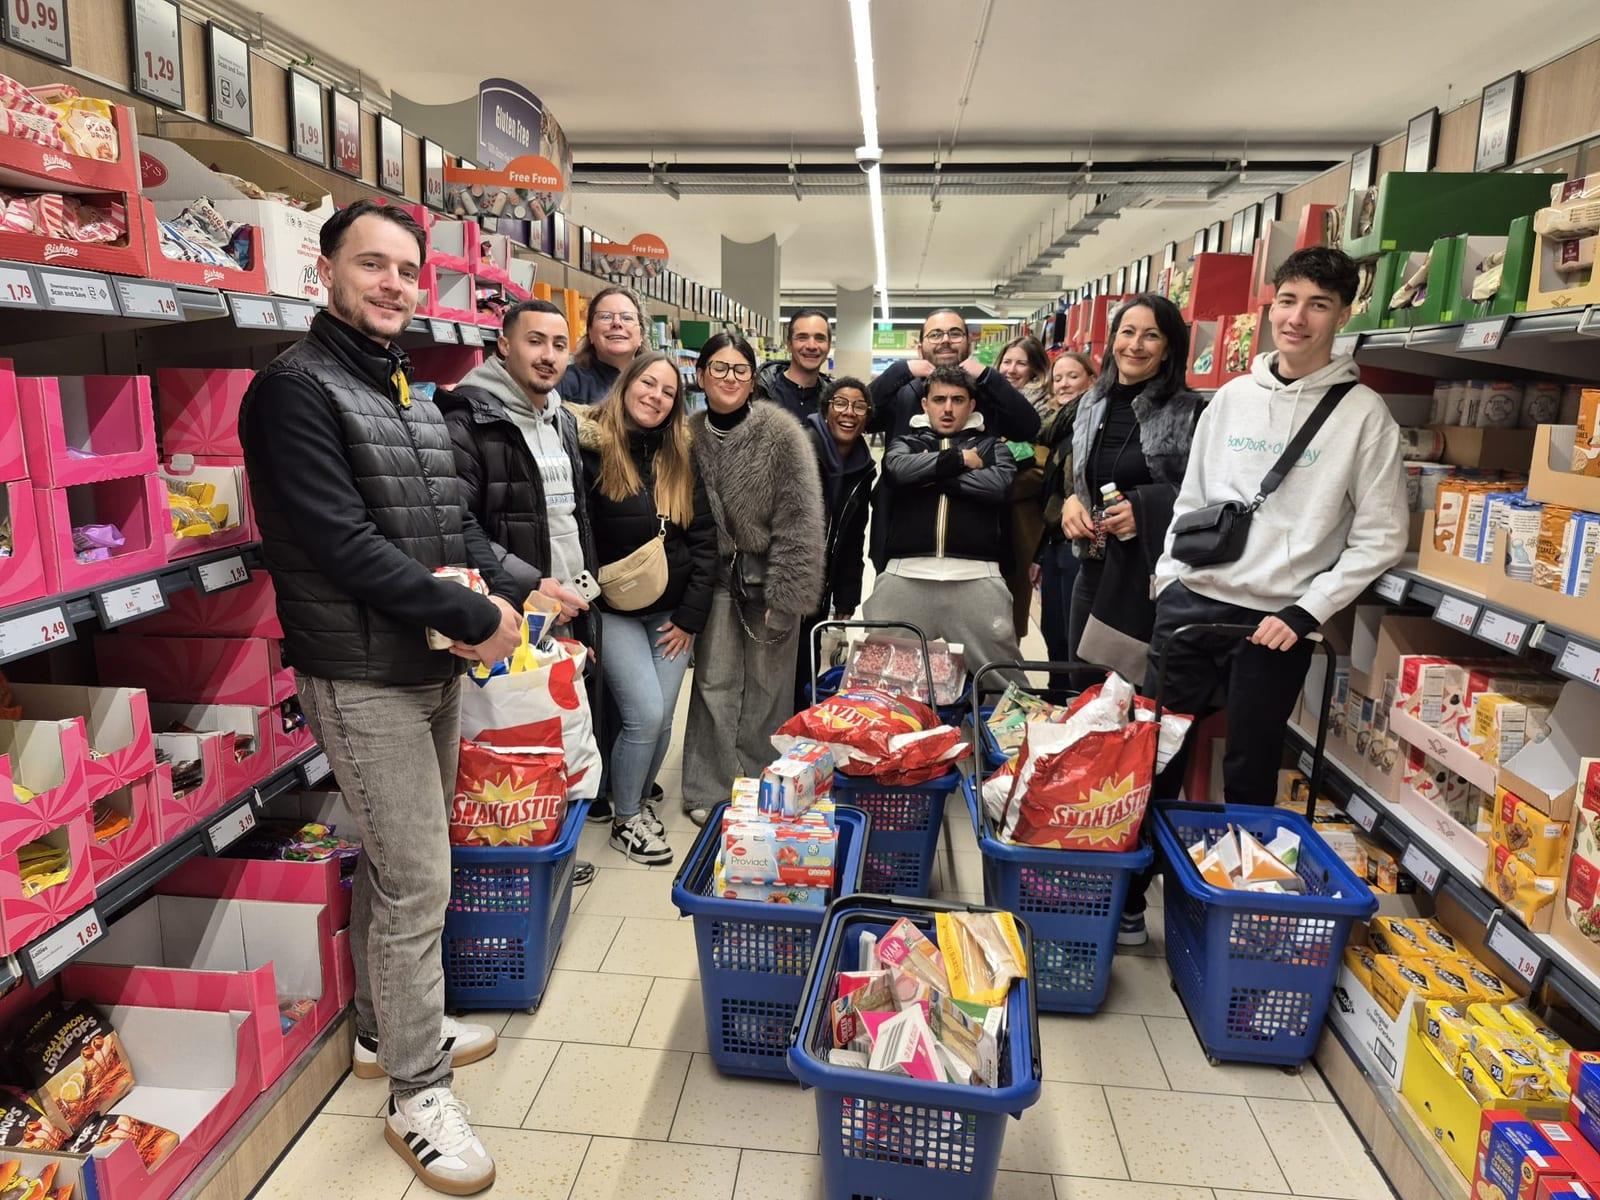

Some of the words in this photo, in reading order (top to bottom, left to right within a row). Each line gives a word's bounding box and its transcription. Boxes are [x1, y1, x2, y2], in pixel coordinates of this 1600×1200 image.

[15, 0, 58, 31] 0.99
[144, 51, 174, 81] 1.29
[299, 122, 319, 145] 1.99
[495, 104, 516, 141] Gluten
[516, 118, 530, 148] Free
[339, 138, 357, 159] 1.29
[42, 153, 73, 171] Bishops
[509, 170, 531, 183] Free
[531, 172, 557, 185] From
[44, 243, 79, 260] Bishops
[632, 243, 647, 254] Free
[647, 245, 665, 255] From
[7, 283, 32, 301] 1.79
[50, 288, 64, 297] Scan
[64, 290, 74, 298] and
[74, 291, 87, 299] Save
[157, 299, 176, 314] 1.49
[230, 566, 246, 582] 1.95
[1459, 613, 1473, 627] 1.99
[40, 620, 66, 642] 2.49
[1504, 630, 1520, 646] 1.19
[238, 813, 254, 834] 3.19
[731, 855, 769, 867] Proviact
[76, 922, 98, 947] 1.89
[31, 945, 49, 960] Lollies
[882, 940, 904, 961] HAM
[1517, 957, 1535, 977] 1.99
[54, 1013, 85, 1041] LEMON
[1428, 1019, 1440, 1038] TUC
[44, 1016, 98, 1075] LOLLIPOPS
[1463, 1067, 1473, 1083] TUC
